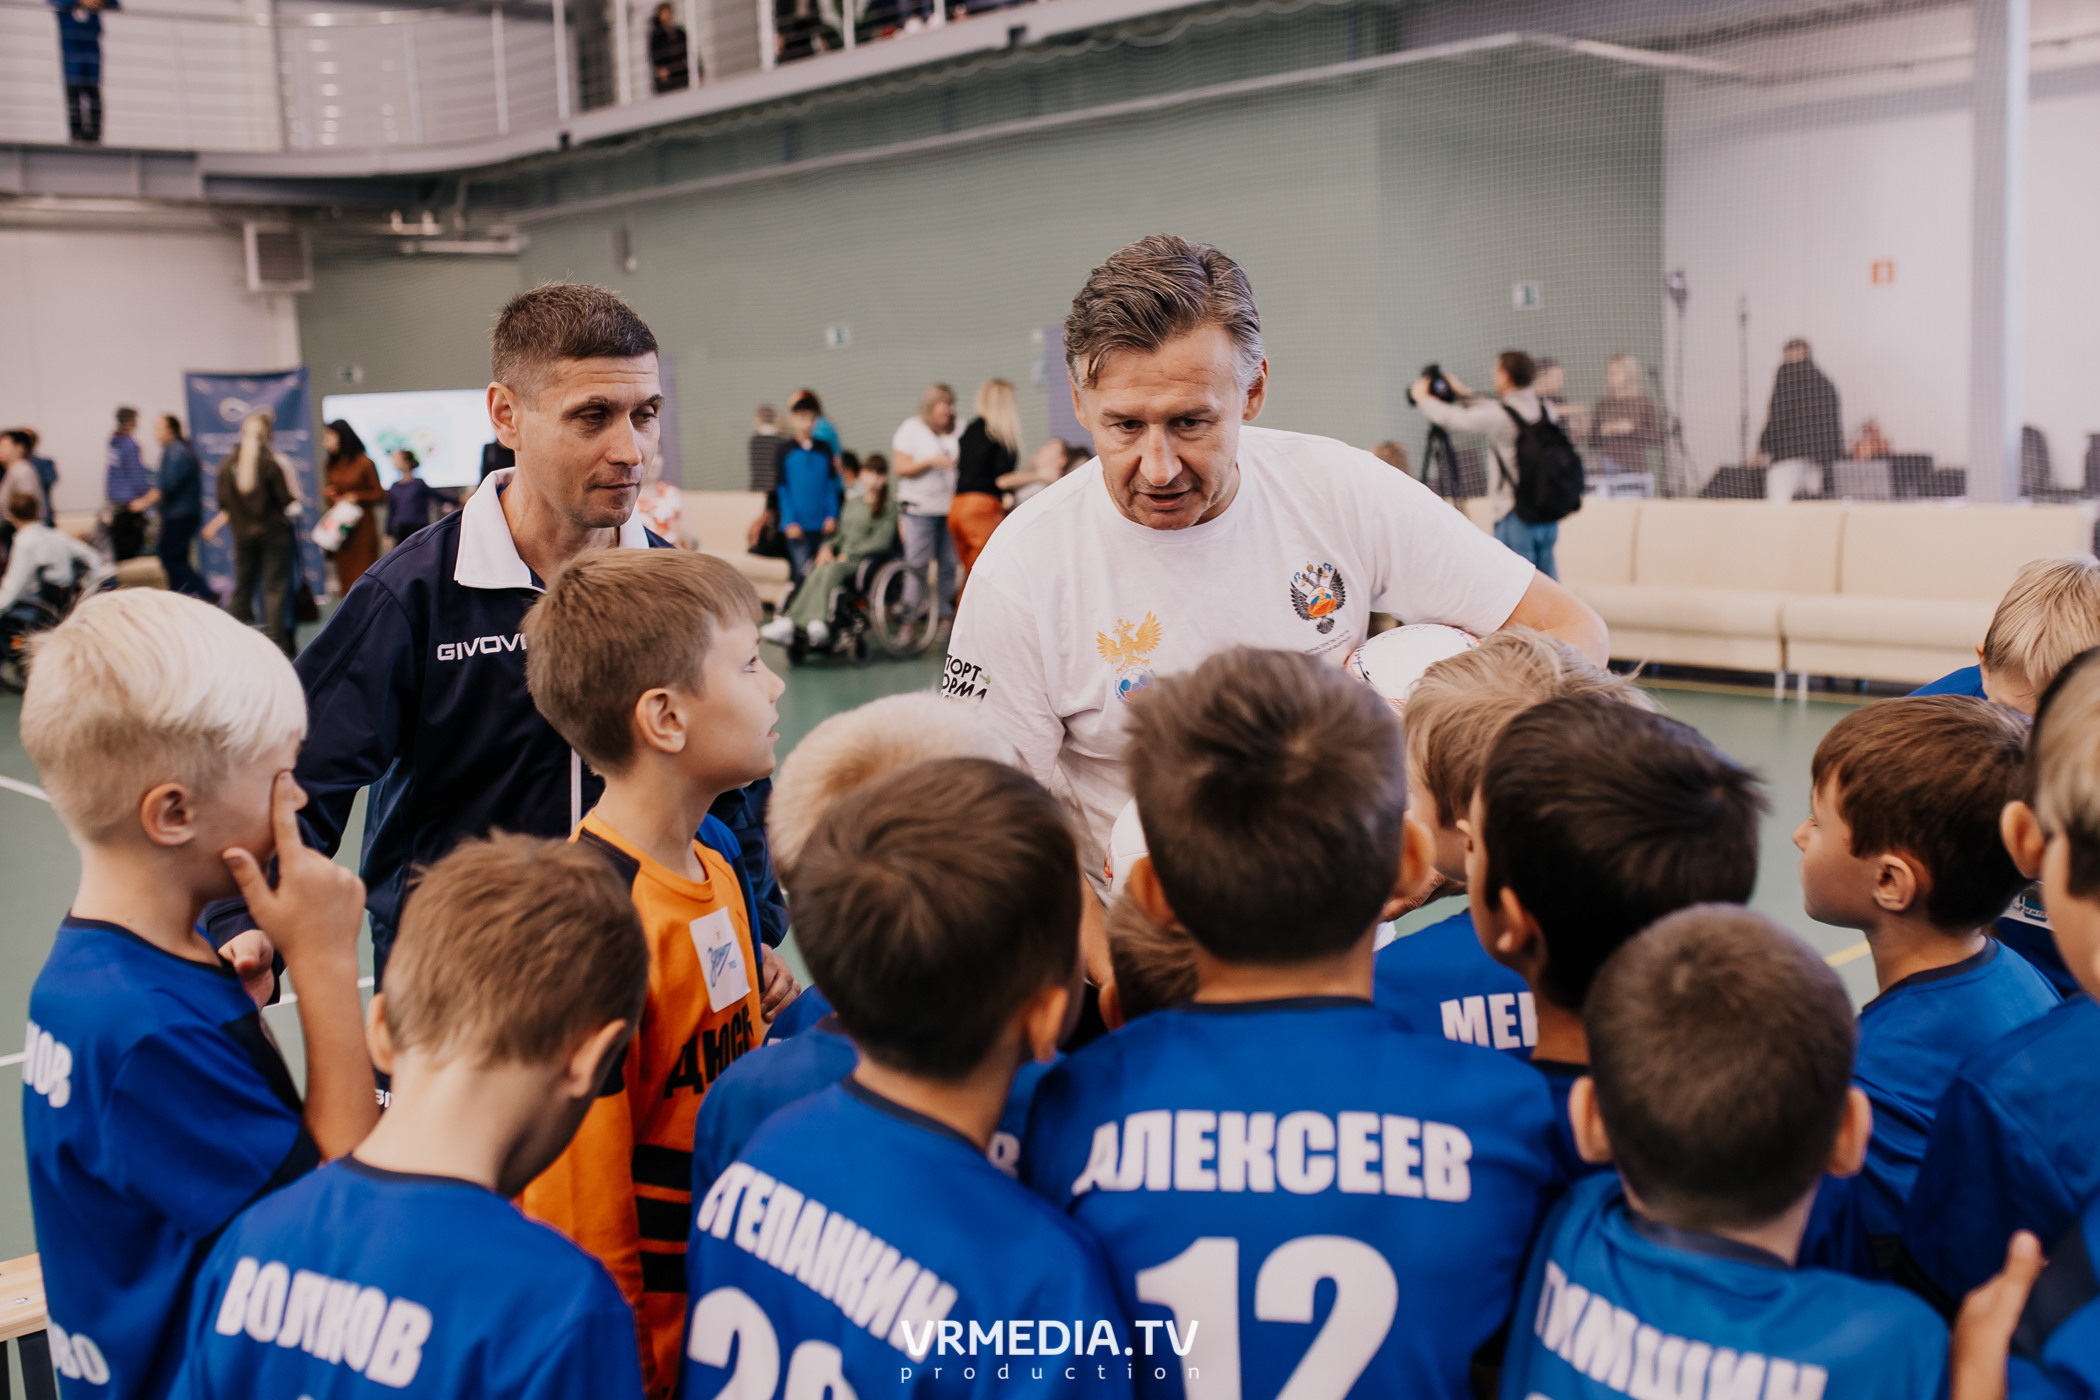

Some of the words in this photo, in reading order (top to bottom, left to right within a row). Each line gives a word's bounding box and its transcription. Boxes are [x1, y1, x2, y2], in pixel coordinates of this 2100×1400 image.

[942, 673, 988, 704] ОРМА
[945, 653, 982, 682] ПОРТ
[1072, 1109, 1473, 1203] АЛЕКСЕЕВ
[215, 1256, 434, 1389] ВОЛКОВ
[1135, 1234, 1399, 1400] 12
